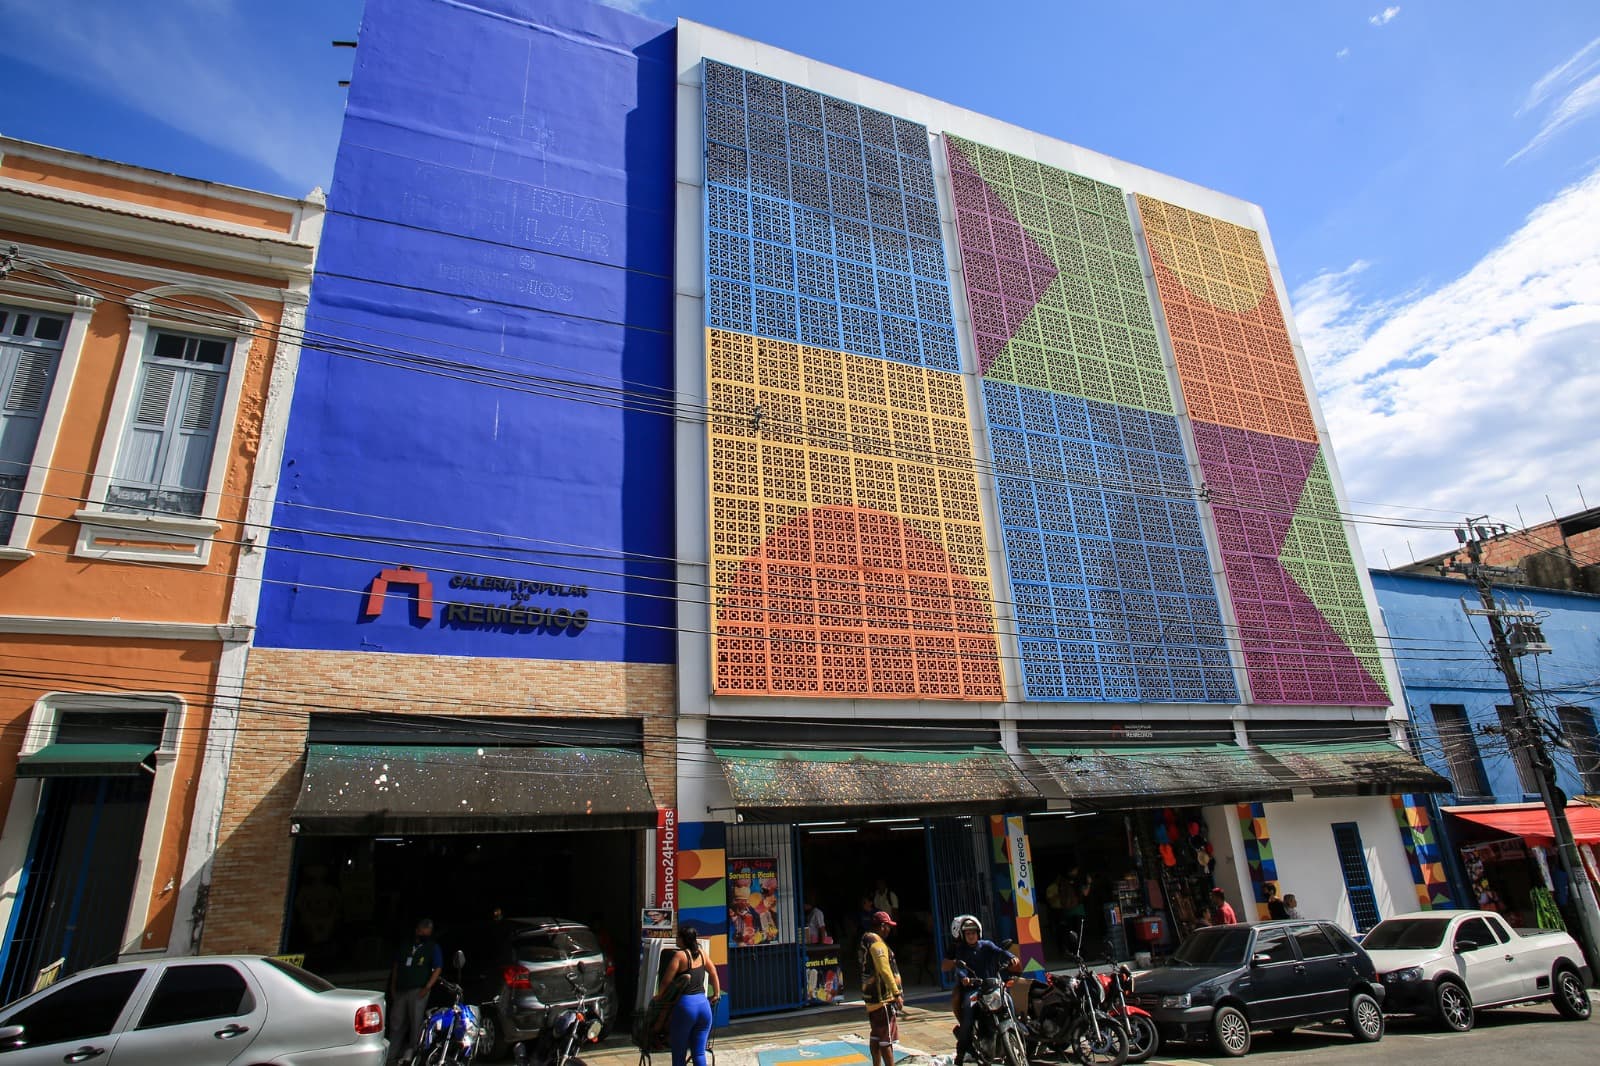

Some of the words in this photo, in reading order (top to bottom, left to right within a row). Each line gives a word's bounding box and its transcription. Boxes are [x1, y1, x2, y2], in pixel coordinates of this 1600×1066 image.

[450, 575, 517, 591] GALERIA
[519, 580, 588, 597] POPULAR
[447, 600, 589, 629] REMÉDIOS
[662, 810, 674, 909] Banco24Horas
[1017, 837, 1028, 878] Correios
